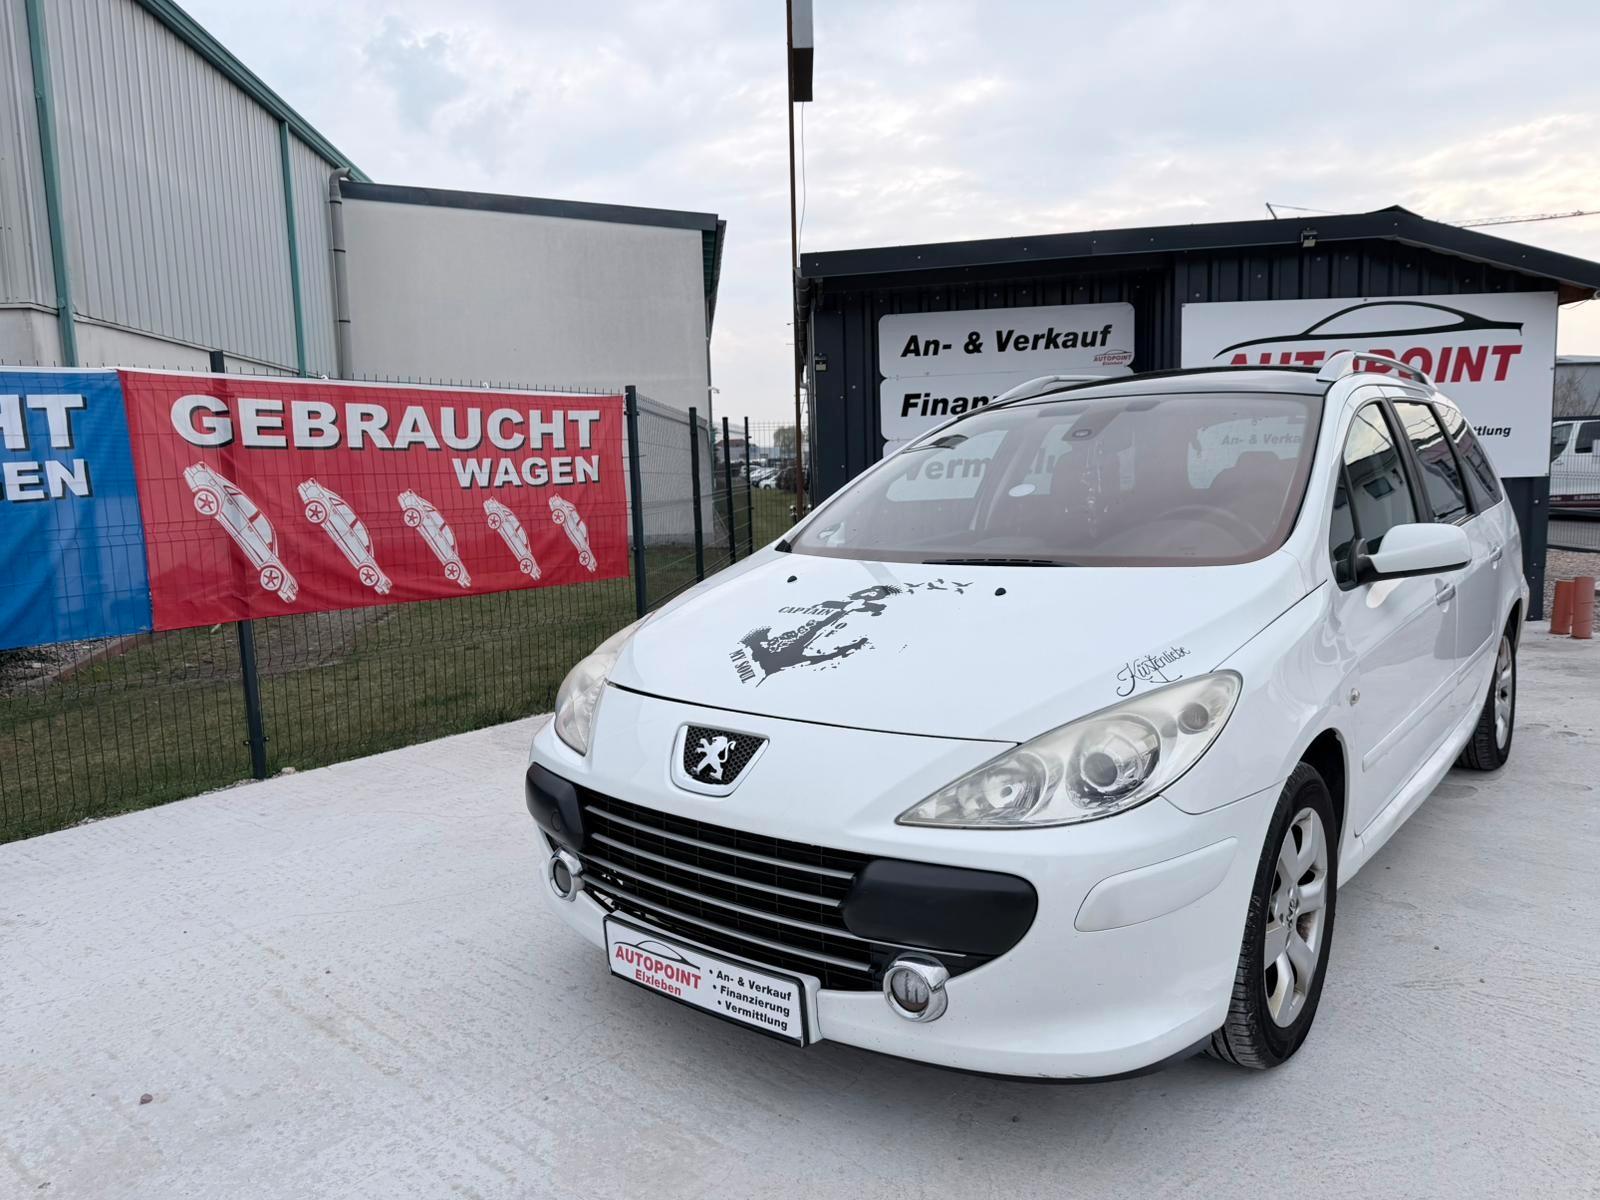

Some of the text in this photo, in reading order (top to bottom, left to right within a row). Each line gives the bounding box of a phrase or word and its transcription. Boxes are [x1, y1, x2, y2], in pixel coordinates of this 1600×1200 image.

[901, 324, 1112, 357] An- & Verkauf
[1230, 345, 1523, 383] POINT
[901, 392, 1000, 417] Finan
[170, 394, 600, 450] GEBRAUCHT
[452, 455, 600, 488] WAGEN
[778, 606, 834, 616] CAPTAIN
[735, 661, 756, 684] SOUL
[615, 945, 702, 990] AUTOPOINT
[635, 969, 682, 996] Elxleben
[716, 970, 792, 1001] An- & Verkauf
[720, 985, 791, 1017] Finanzierung
[725, 1000, 788, 1031] Vermittlung
